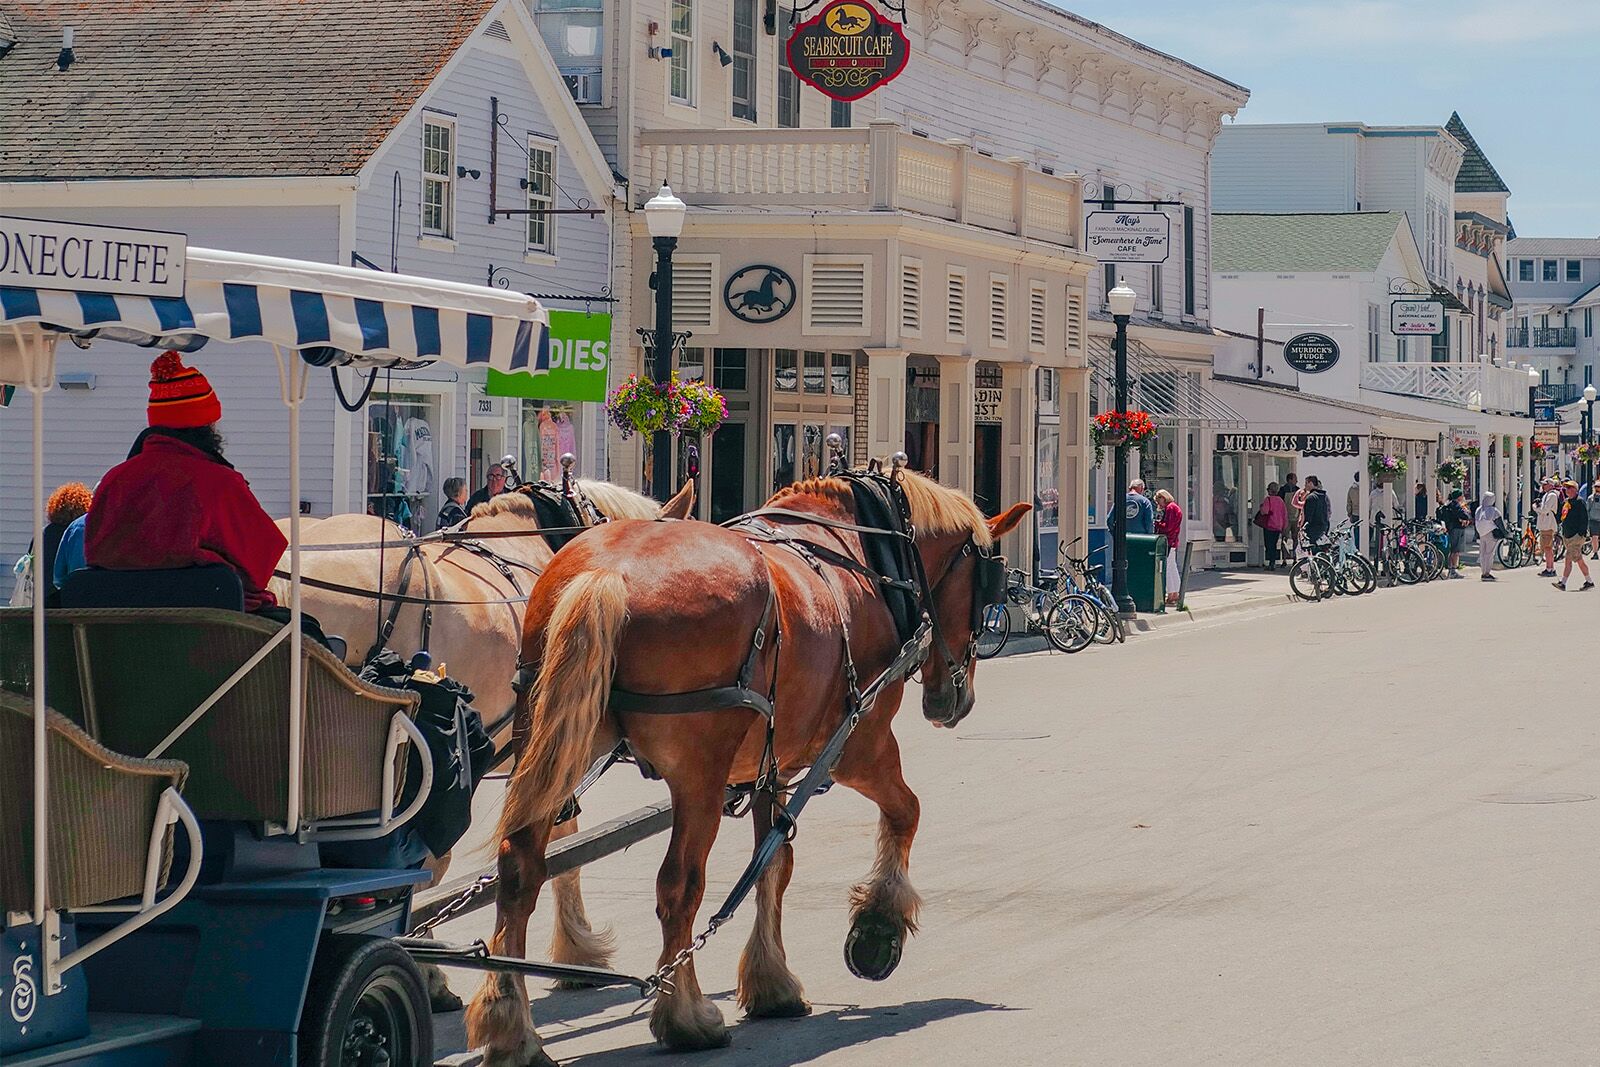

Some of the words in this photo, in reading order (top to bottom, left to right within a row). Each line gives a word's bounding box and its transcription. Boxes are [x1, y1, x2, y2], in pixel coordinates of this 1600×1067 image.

[804, 35, 863, 56] SEABISCUIT
[864, 32, 893, 56] CAFÉ
[1115, 215, 1140, 226] May's
[1135, 236, 1142, 245] in
[549, 338, 607, 371] DIES
[975, 390, 1002, 402] DIN
[478, 399, 492, 412] 7331
[1223, 435, 1298, 450] MURDICKS
[1306, 435, 1352, 451] FUDGE
